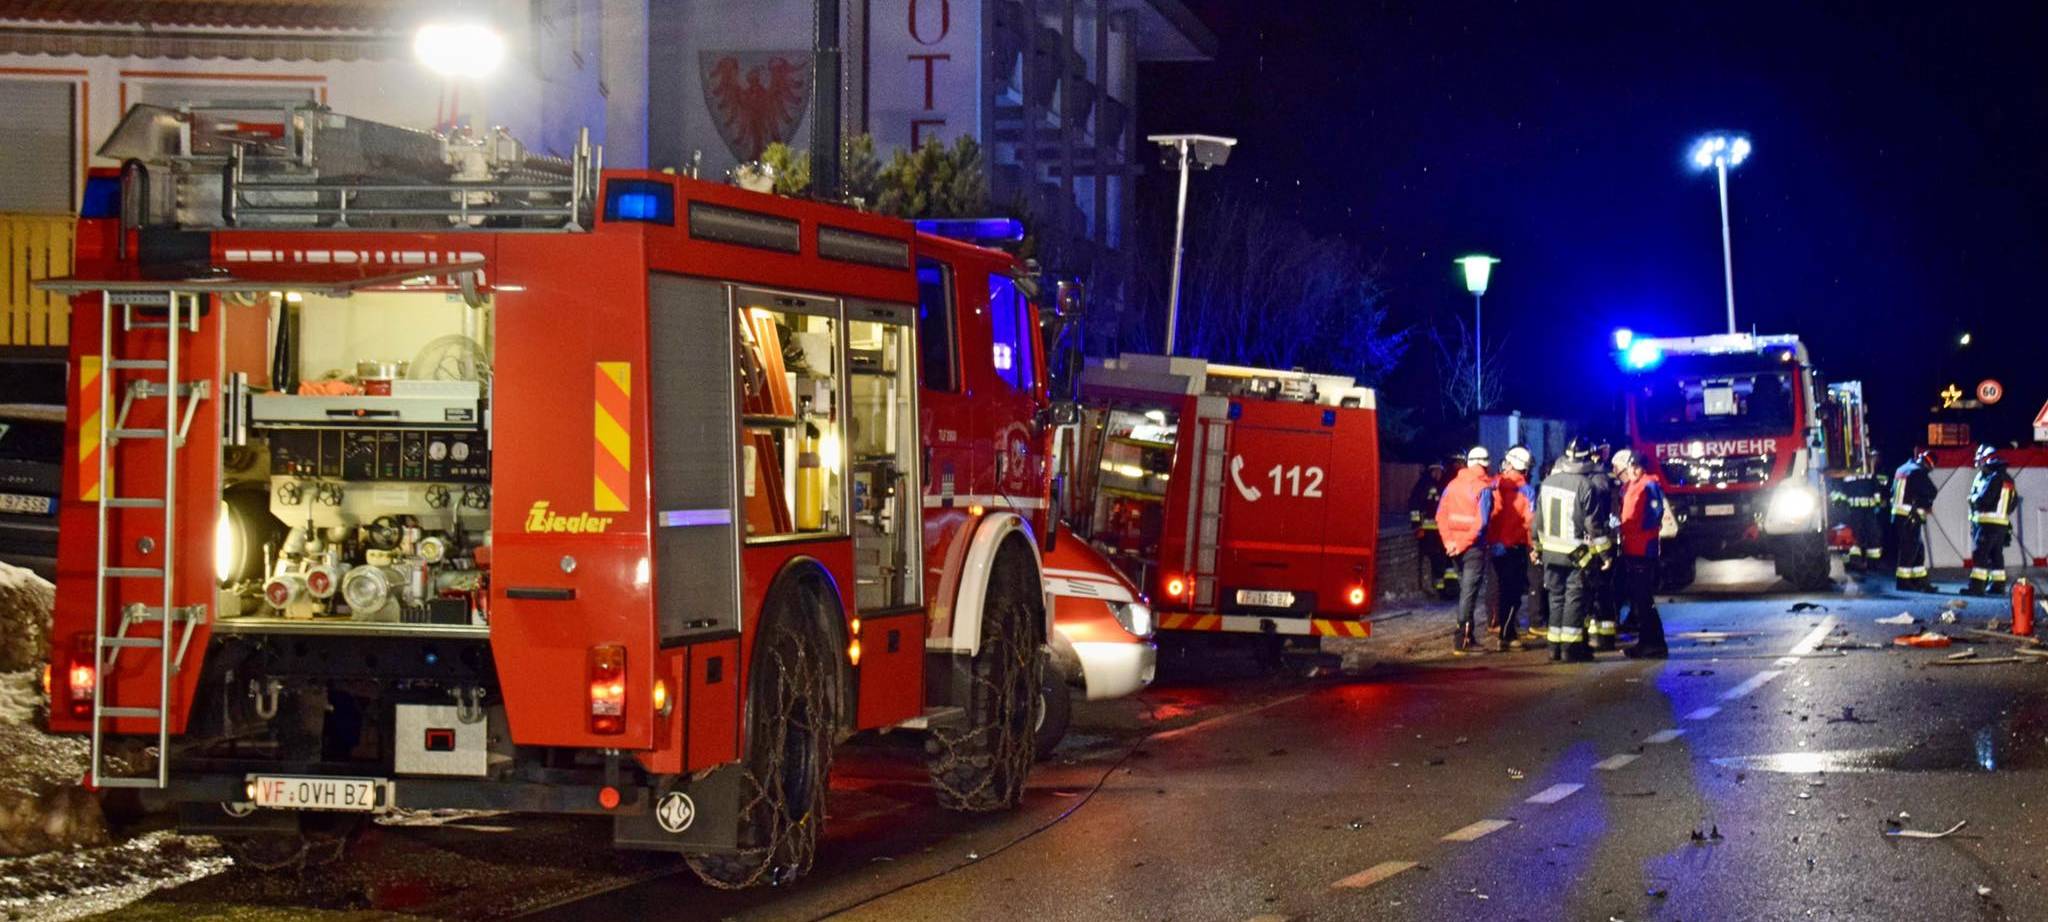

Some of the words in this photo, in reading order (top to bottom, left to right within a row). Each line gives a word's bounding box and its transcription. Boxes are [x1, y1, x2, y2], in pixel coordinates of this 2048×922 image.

[1983, 386, 1996, 397] 60
[1656, 439, 1777, 457] FEURWEHR
[1268, 464, 1324, 498] 112
[525, 501, 613, 534] Ziegler
[263, 781, 285, 803] VF
[345, 784, 368, 806] BZ
